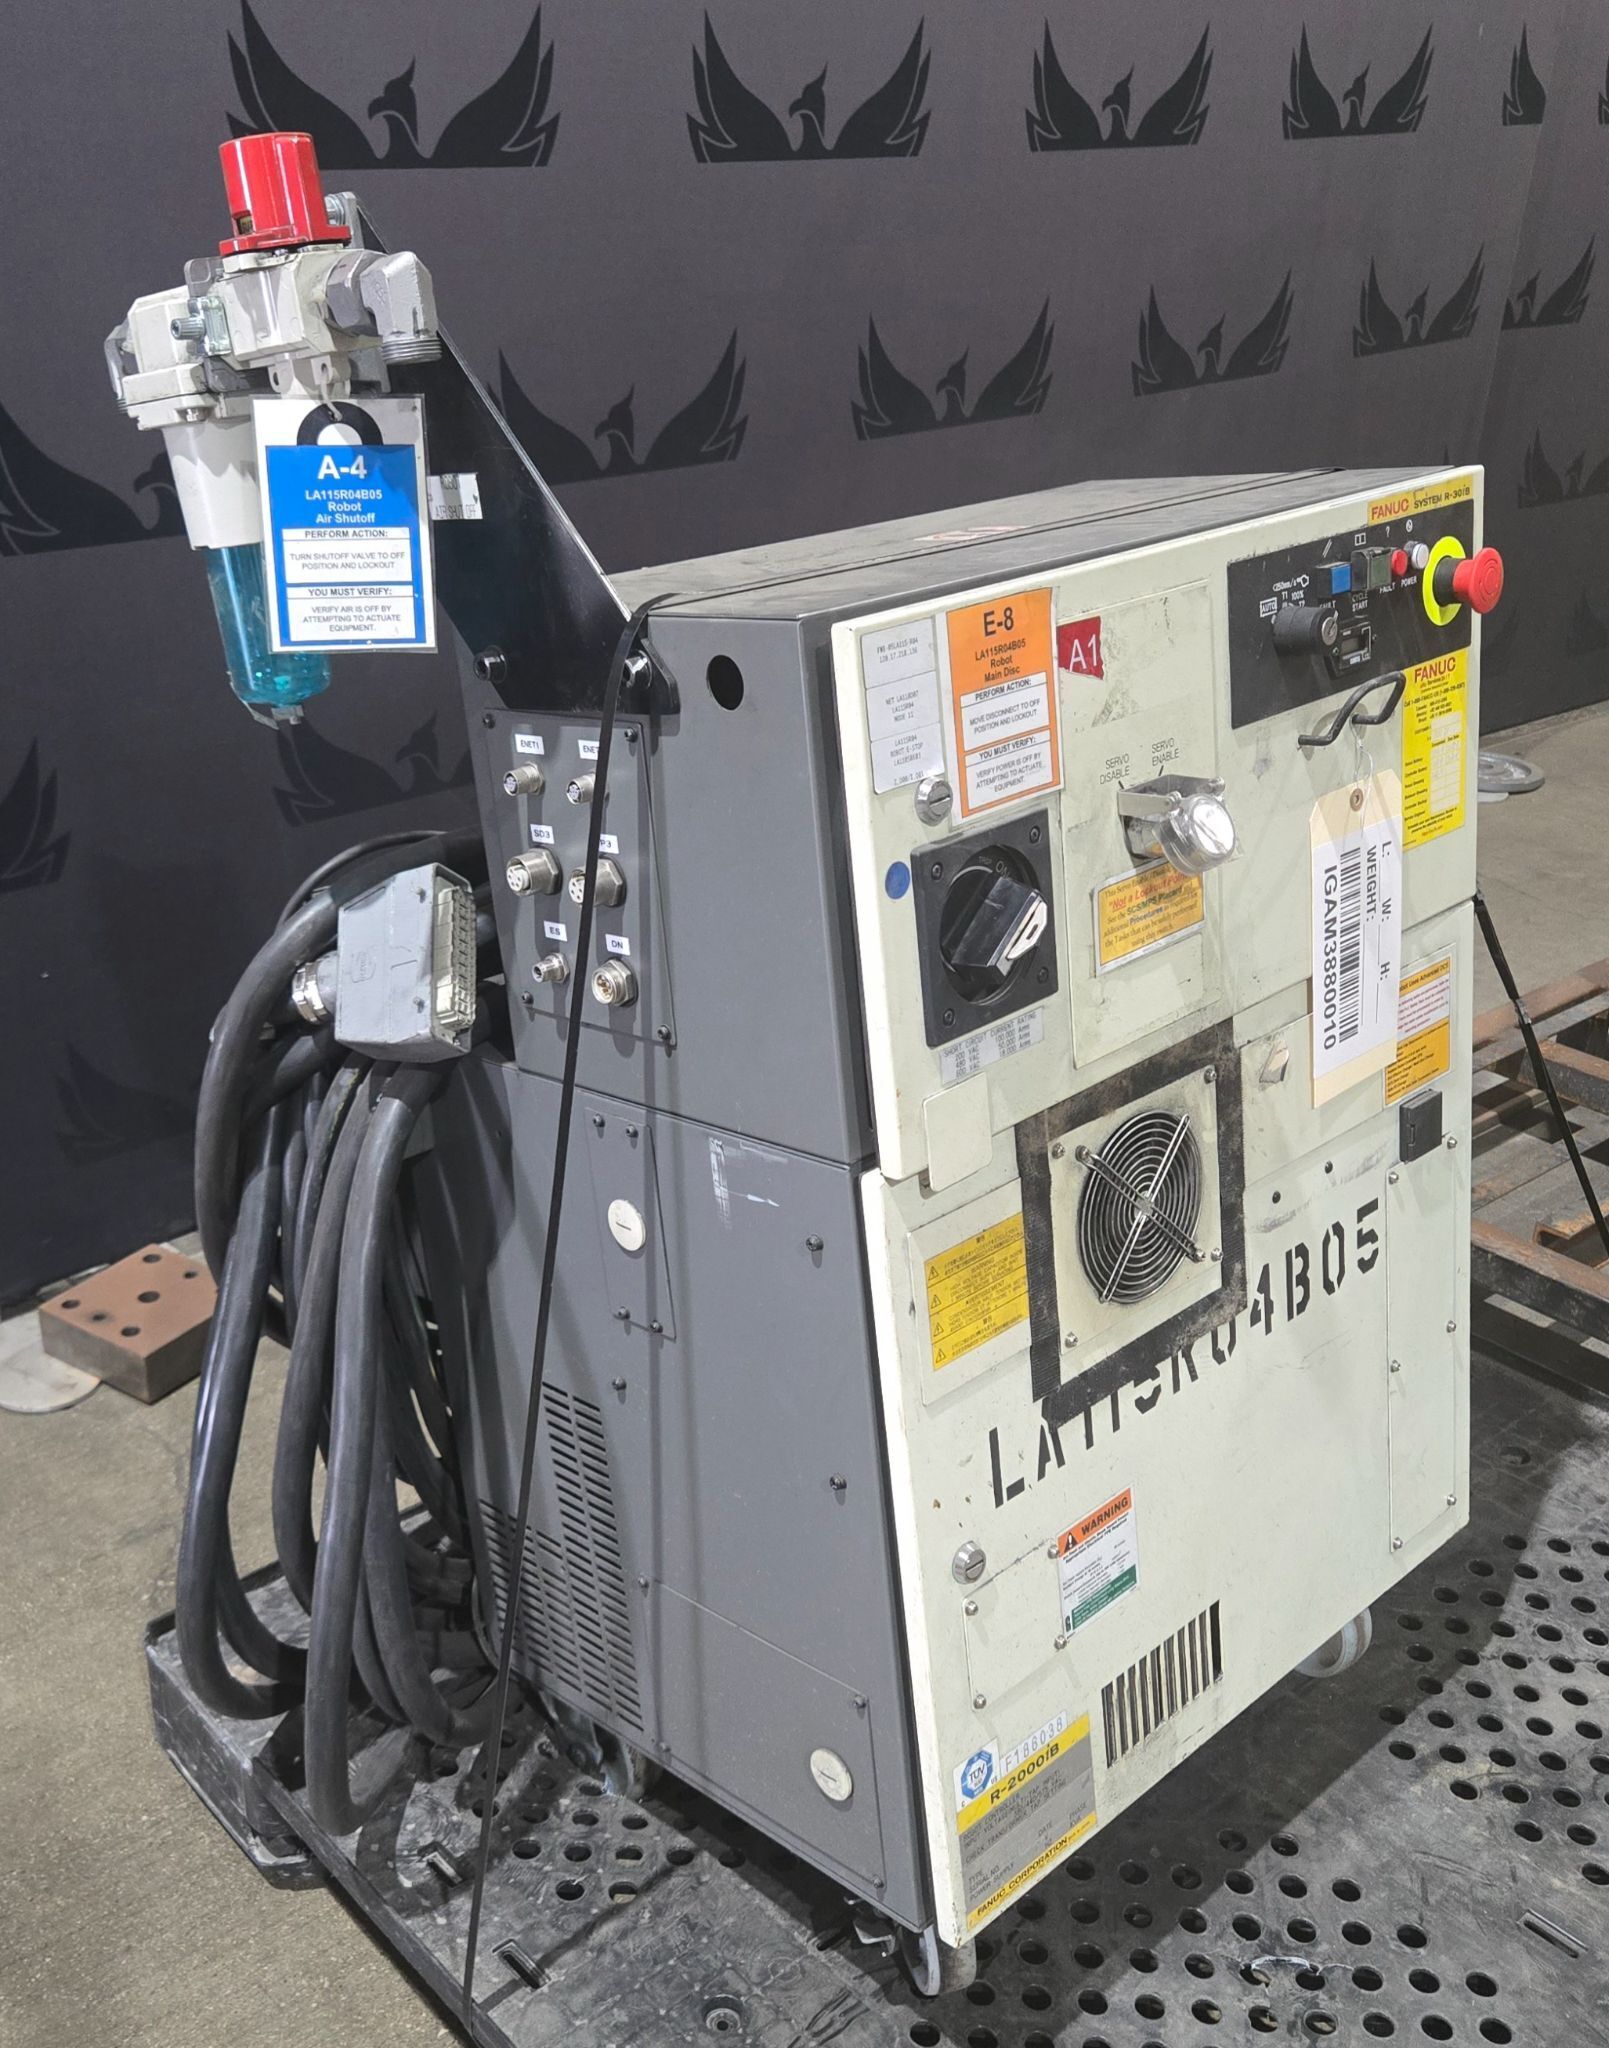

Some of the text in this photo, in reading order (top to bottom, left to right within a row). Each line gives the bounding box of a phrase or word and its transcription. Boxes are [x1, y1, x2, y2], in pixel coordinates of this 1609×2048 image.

[317, 454, 367, 480] A-4
[305, 489, 382, 500] LA115R04B05
[1371, 483, 1471, 520] FANUC SYSTEM R-30iB
[328, 501, 362, 512] Robot
[316, 513, 376, 523] Air Shutoff
[304, 530, 349, 538] PERFORM
[313, 552, 349, 560] SHUTOFF
[390, 551, 405, 559] OFF
[302, 562, 339, 570] POSITION
[358, 561, 395, 569] LOCKOUT
[1400, 575, 1417, 588] POWER
[330, 588, 355, 596] MUST
[357, 587, 392, 595] VERIFY:
[1281, 591, 1288, 600] T1
[1262, 602, 1276, 613] AUTO
[1352, 600, 1368, 612] START
[303, 615, 352, 623] ATTEMPTING
[366, 614, 401, 622] ACTUATE
[983, 606, 1014, 637] E-8
[975, 638, 1026, 661] LA115R04B05
[1069, 633, 1097, 672] A1
[990, 655, 1013, 668] Robot
[1414, 656, 1456, 683] FANUC
[984, 666, 1020, 682] Main Disc
[975, 678, 1031, 700] PERFORM ACTION:
[969, 714, 985, 727] MOVE
[985, 703, 1019, 720] DISCONNECT
[1029, 699, 1040, 707] OFF
[974, 709, 1037, 734] POSITION AND LOCKOUT
[979, 736, 1036, 760] YOU MUST VERIFY:
[1152, 738, 1175, 754] SERVO
[976, 766, 994, 778] VERIFY
[995, 761, 1015, 773] POWER
[1022, 755, 1033, 765] OFF
[1034, 752, 1042, 760] BY
[1105, 753, 1130, 770] SERVO
[1152, 748, 1180, 767] ENABLE
[1099, 765, 1130, 785] DISABLE
[533, 828, 550, 839] SD3
[600, 840, 612, 849] P3
[1365, 845, 1377, 922] WEIGHT:
[1379, 839, 1392, 982] L: W: H:
[550, 926, 561, 936] ES
[611, 939, 624, 949] DN
[1323, 864, 1338, 1051] IGAM3880010
[1081, 1497, 1129, 1535] WARNING
[1005, 1717, 1064, 1773] F186038
[990, 1743, 1060, 1804] R-2000iB
[976, 1835, 1067, 1917] FANUC CORPORATION
